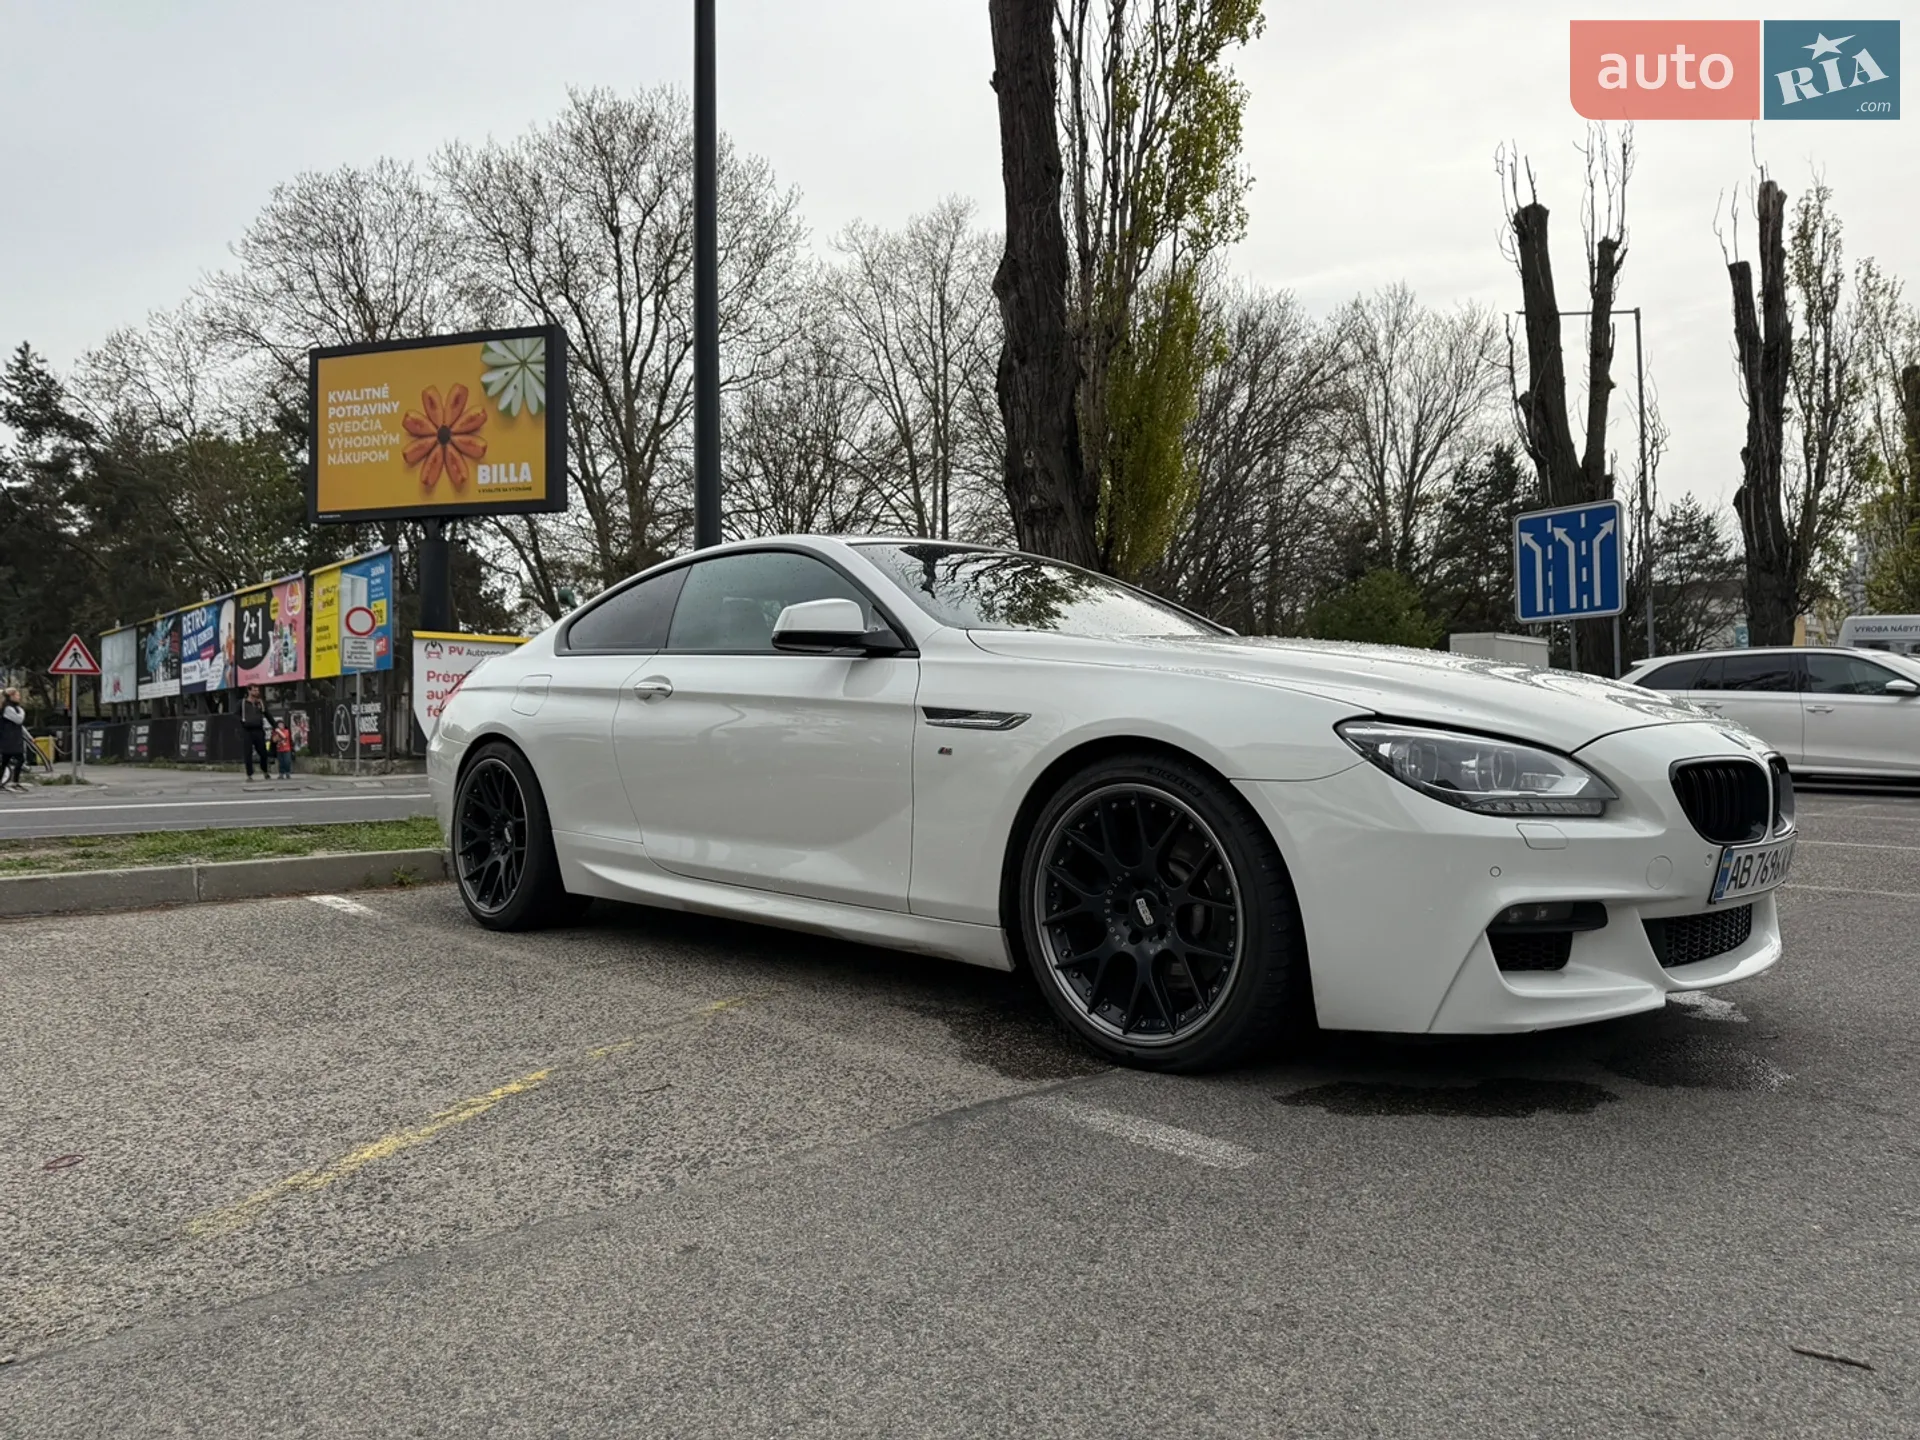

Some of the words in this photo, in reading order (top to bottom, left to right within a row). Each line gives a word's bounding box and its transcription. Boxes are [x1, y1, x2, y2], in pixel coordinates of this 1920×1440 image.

[328, 383, 389, 403] KVALITNÉ
[328, 401, 400, 419] POTRAVINY
[328, 416, 382, 434] SVEDČIA
[328, 430, 400, 450] VÝHODNÝM
[328, 449, 389, 465] NÁKUPOM
[477, 462, 533, 485] BILLA
[182, 607, 207, 636] RETRO
[242, 607, 263, 643] 2+1
[183, 634, 197, 657] RUN
[448, 645, 465, 656] PV
[1726, 854, 1754, 891] AB
[1135, 897, 1155, 926] BBS
